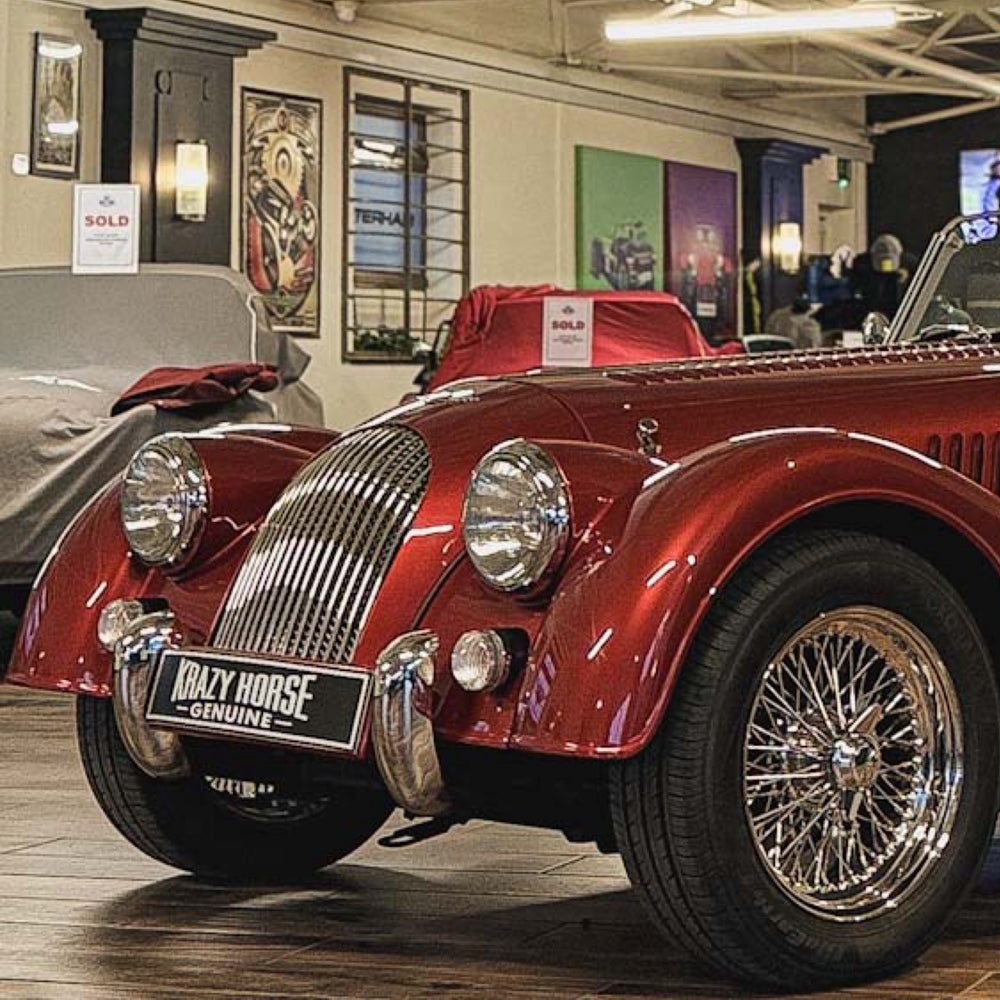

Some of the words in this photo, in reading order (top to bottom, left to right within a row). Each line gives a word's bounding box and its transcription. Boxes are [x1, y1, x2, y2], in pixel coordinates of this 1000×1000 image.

[85, 215, 129, 227] SOLD
[551, 320, 586, 331] SOLD
[171, 657, 236, 702] KRAZY
[235, 673, 317, 721] HORSE
